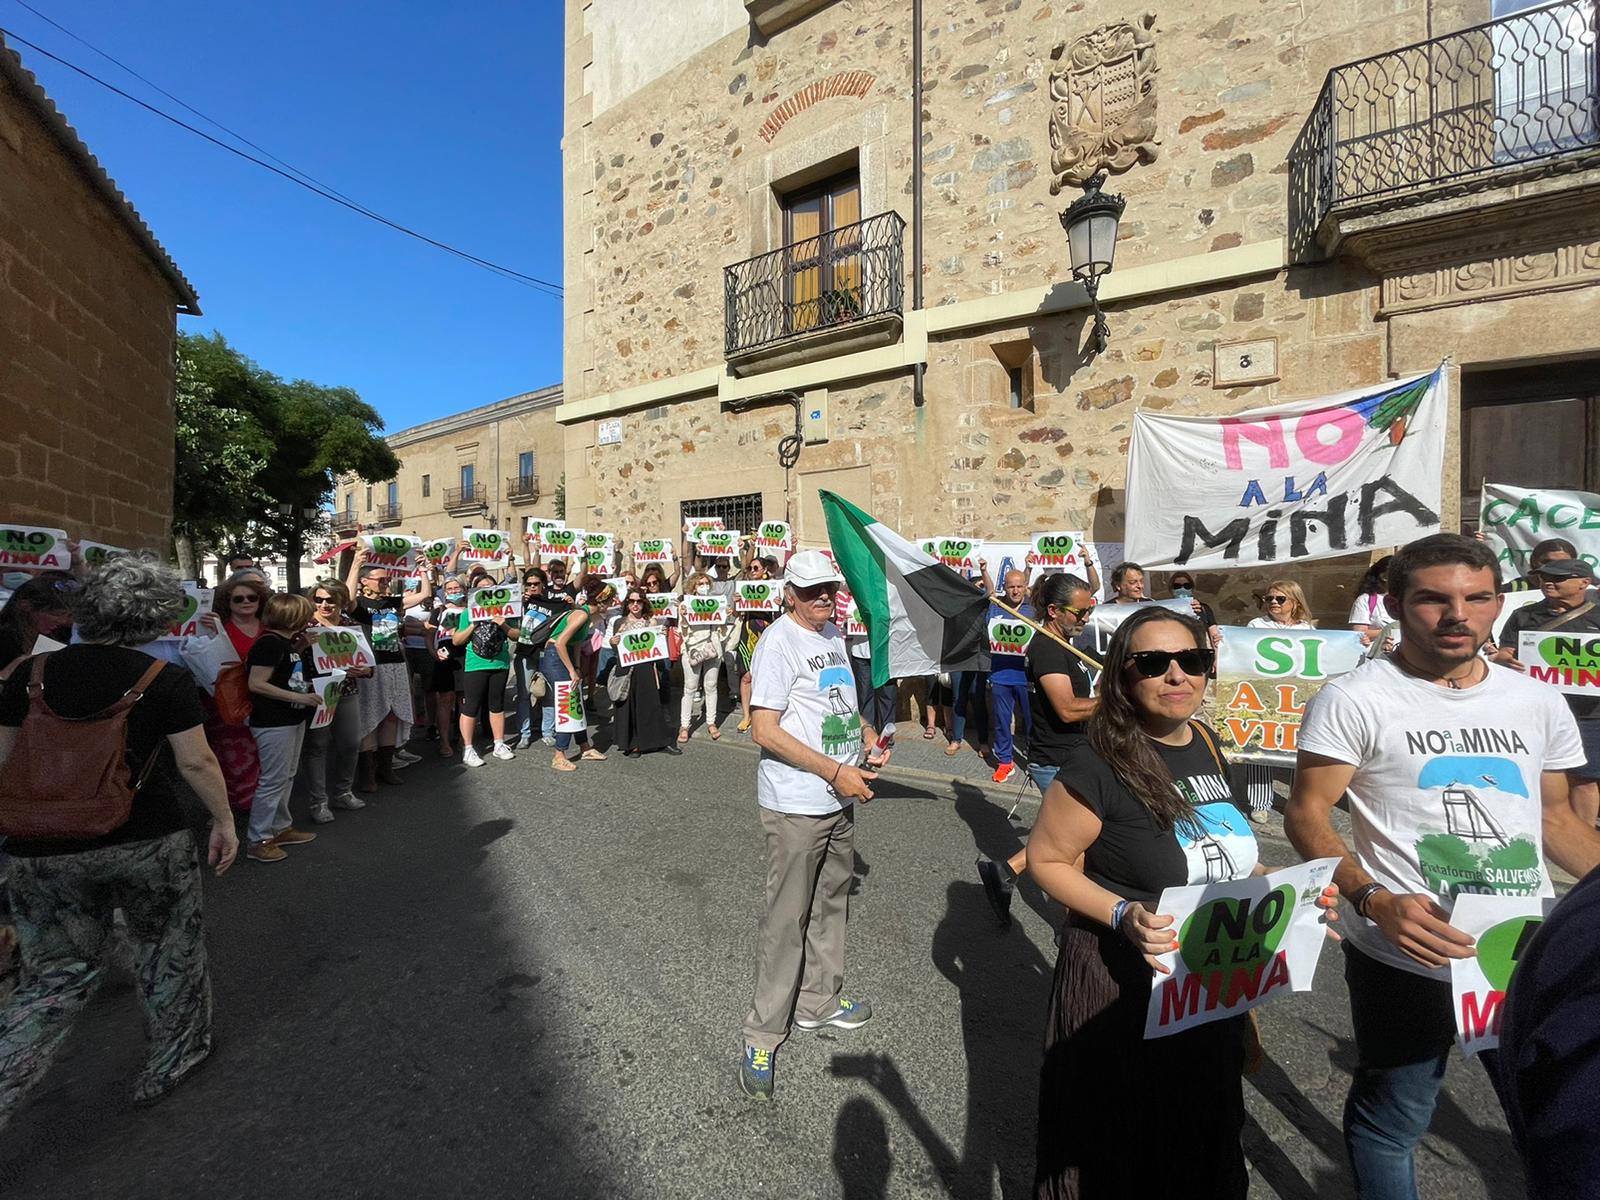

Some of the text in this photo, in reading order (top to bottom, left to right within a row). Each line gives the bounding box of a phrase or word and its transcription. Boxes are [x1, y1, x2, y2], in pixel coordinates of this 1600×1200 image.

[1218, 407, 1366, 471] NO
[1239, 471, 1328, 507] A LA
[6, 530, 47, 544] NO
[476, 533, 497, 543] NO
[551, 530, 571, 539] NO
[589, 534, 604, 542] NO
[379, 536, 406, 548] NO
[945, 540, 967, 550] NO
[1044, 536, 1067, 547] NO
[466, 549, 503, 559] MINA
[542, 544, 578, 554] MINA
[636, 551, 667, 560] MINA
[703, 545, 734, 554] MINA
[365, 552, 407, 567] MINA
[1033, 554, 1077, 565] MINA
[482, 589, 506, 600] NO
[747, 584, 766, 594] NO
[697, 598, 715, 607] NO
[739, 600, 773, 609] MINA
[472, 605, 514, 618] MINA
[688, 612, 722, 622] MINA
[1000, 624, 1026, 637] NO
[326, 631, 352, 646] NO
[629, 631, 650, 644] NO
[318, 651, 368, 670] MINA
[622, 647, 662, 663] MINA
[1255, 636, 1325, 677] SI
[807, 655, 825, 672] NO
[1228, 682, 1305, 714] A L
[558, 685, 569, 725] MINA
[1406, 728, 1529, 755] NO a la MINA
[1177, 780, 1186, 790] a
[1185, 791, 1200, 803] la
[1205, 889, 1285, 943] NO
[1159, 950, 1289, 1026] MINA
